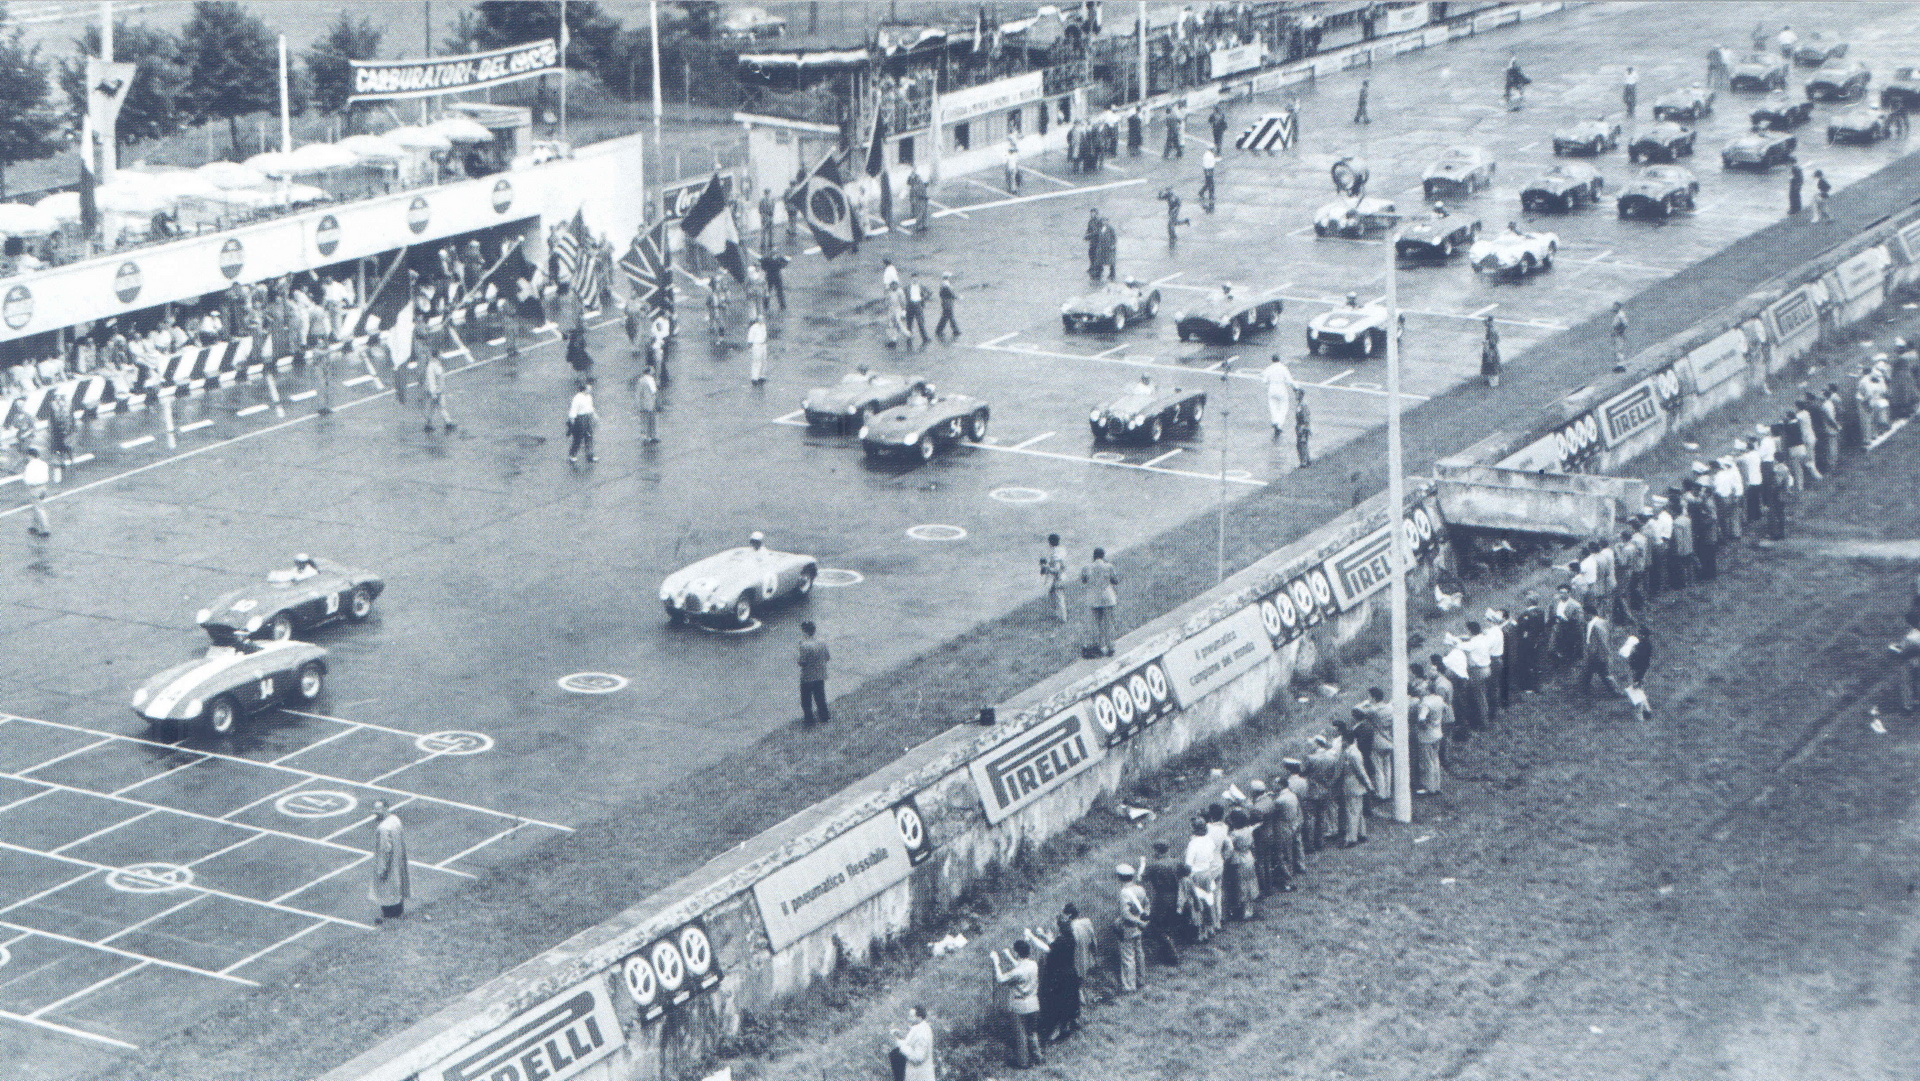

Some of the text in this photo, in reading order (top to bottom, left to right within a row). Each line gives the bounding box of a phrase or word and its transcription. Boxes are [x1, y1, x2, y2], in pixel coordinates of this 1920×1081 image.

[950, 418, 962, 438] 54
[1605, 385, 1656, 440] PIRELLI
[1334, 530, 1408, 600] PIREL
[260, 678, 274, 699] 14
[985, 714, 1089, 809] PIRELLI
[791, 872, 845, 914] pneumatico
[442, 990, 605, 1081] PELLI
